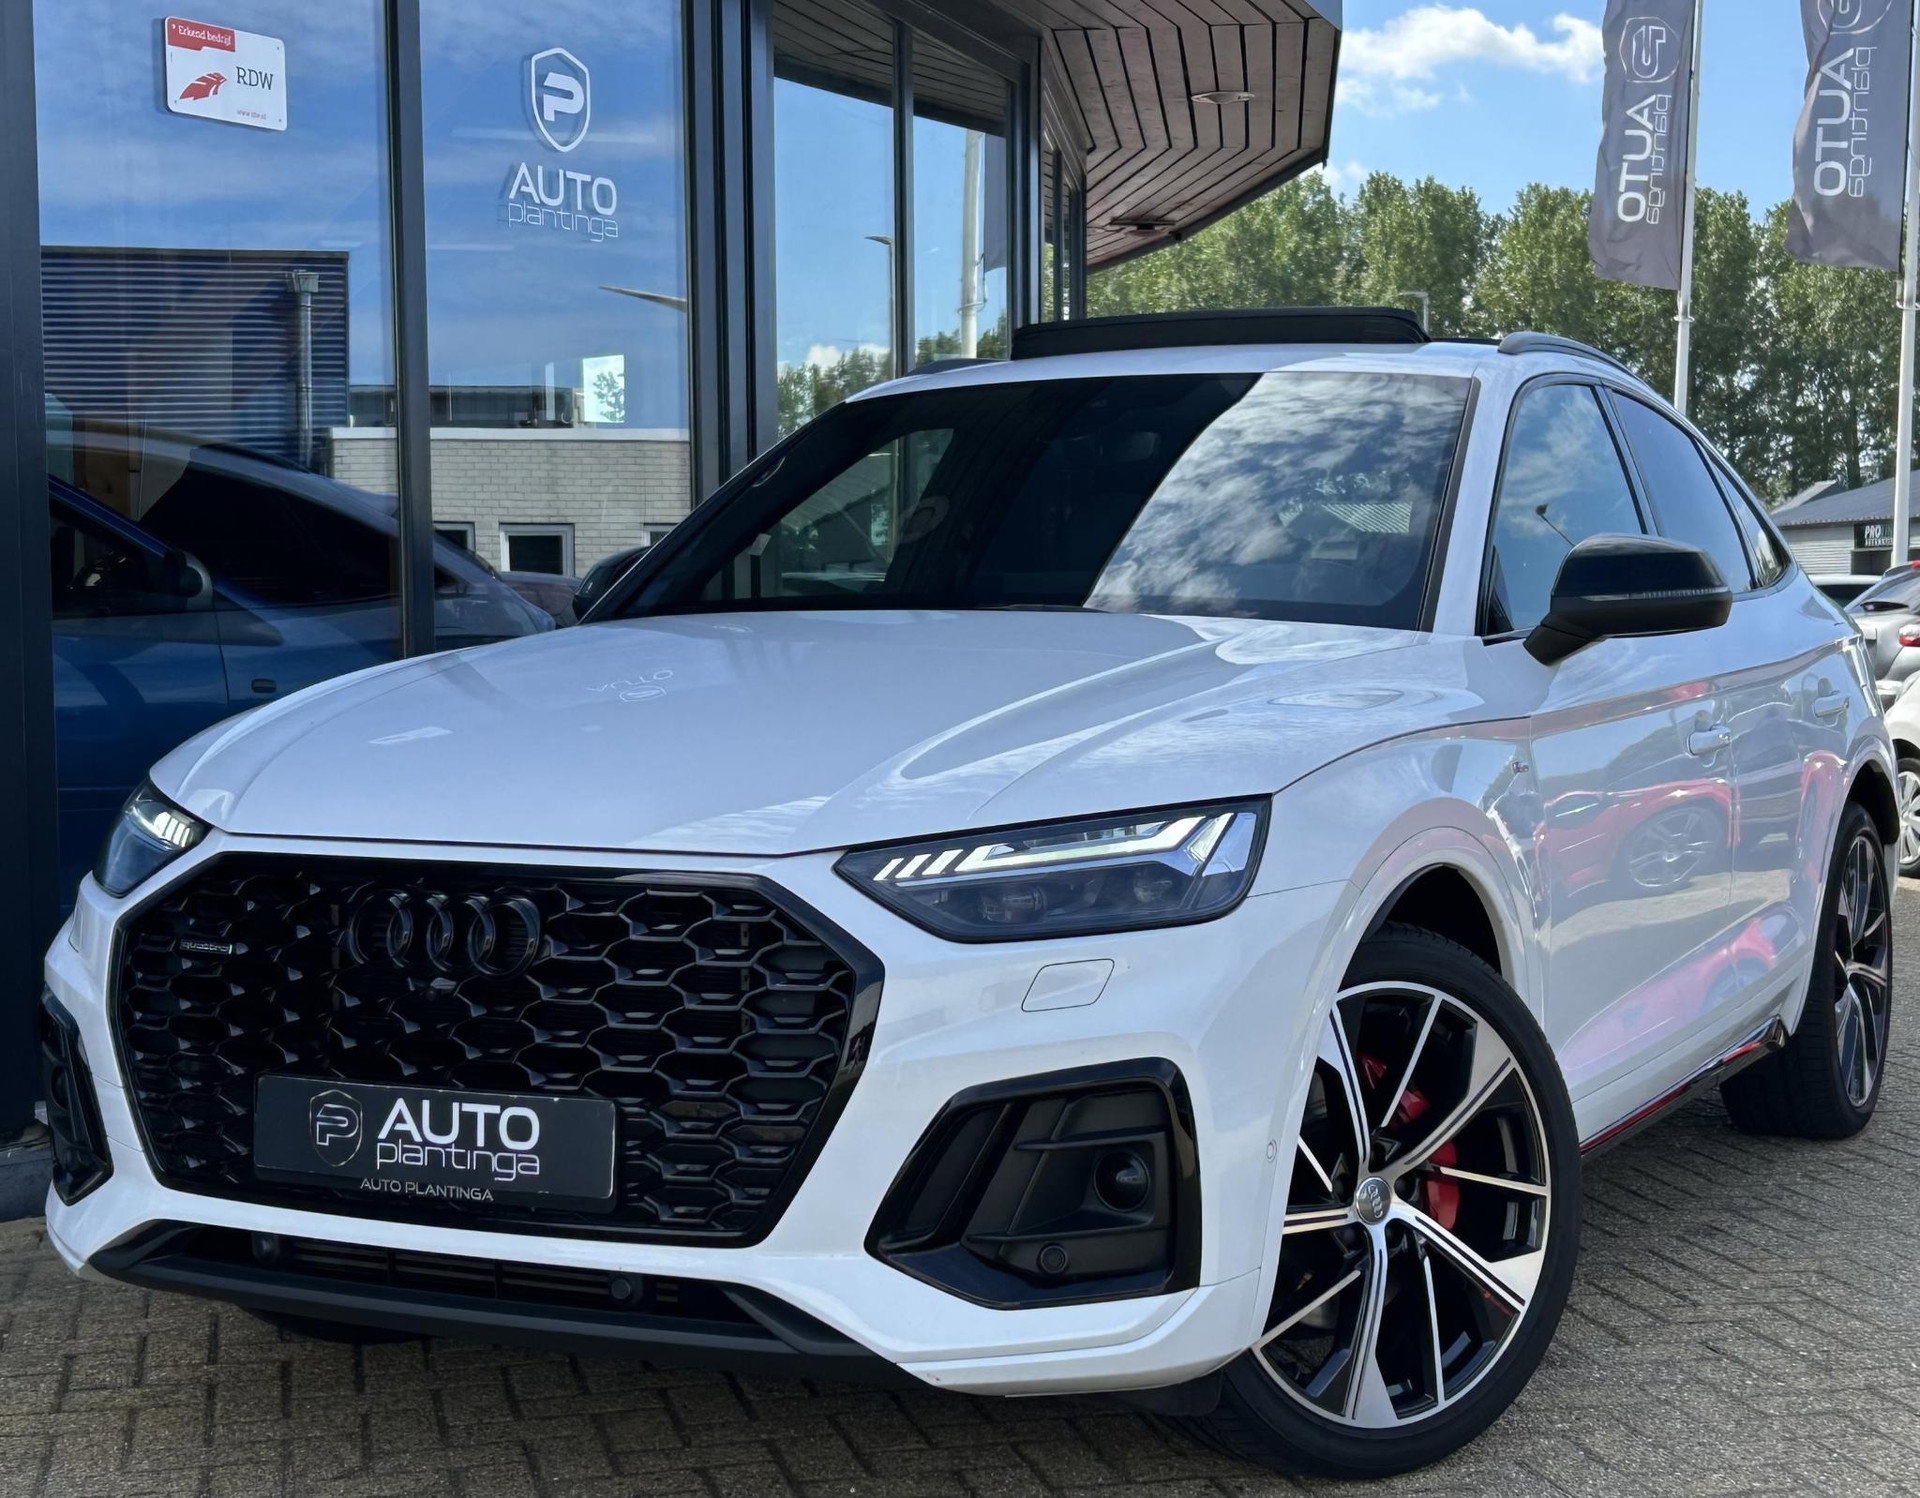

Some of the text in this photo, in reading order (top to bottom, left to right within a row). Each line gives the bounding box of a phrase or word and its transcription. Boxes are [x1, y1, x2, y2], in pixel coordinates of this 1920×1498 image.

[236, 66, 273, 90] RDW
[509, 162, 617, 215] AUTO
[508, 202, 618, 242] plantinga
[377, 1097, 540, 1151] AUTO
[376, 1142, 540, 1182] plantinga
[360, 1177, 494, 1202] AUTO PLANTINGA
